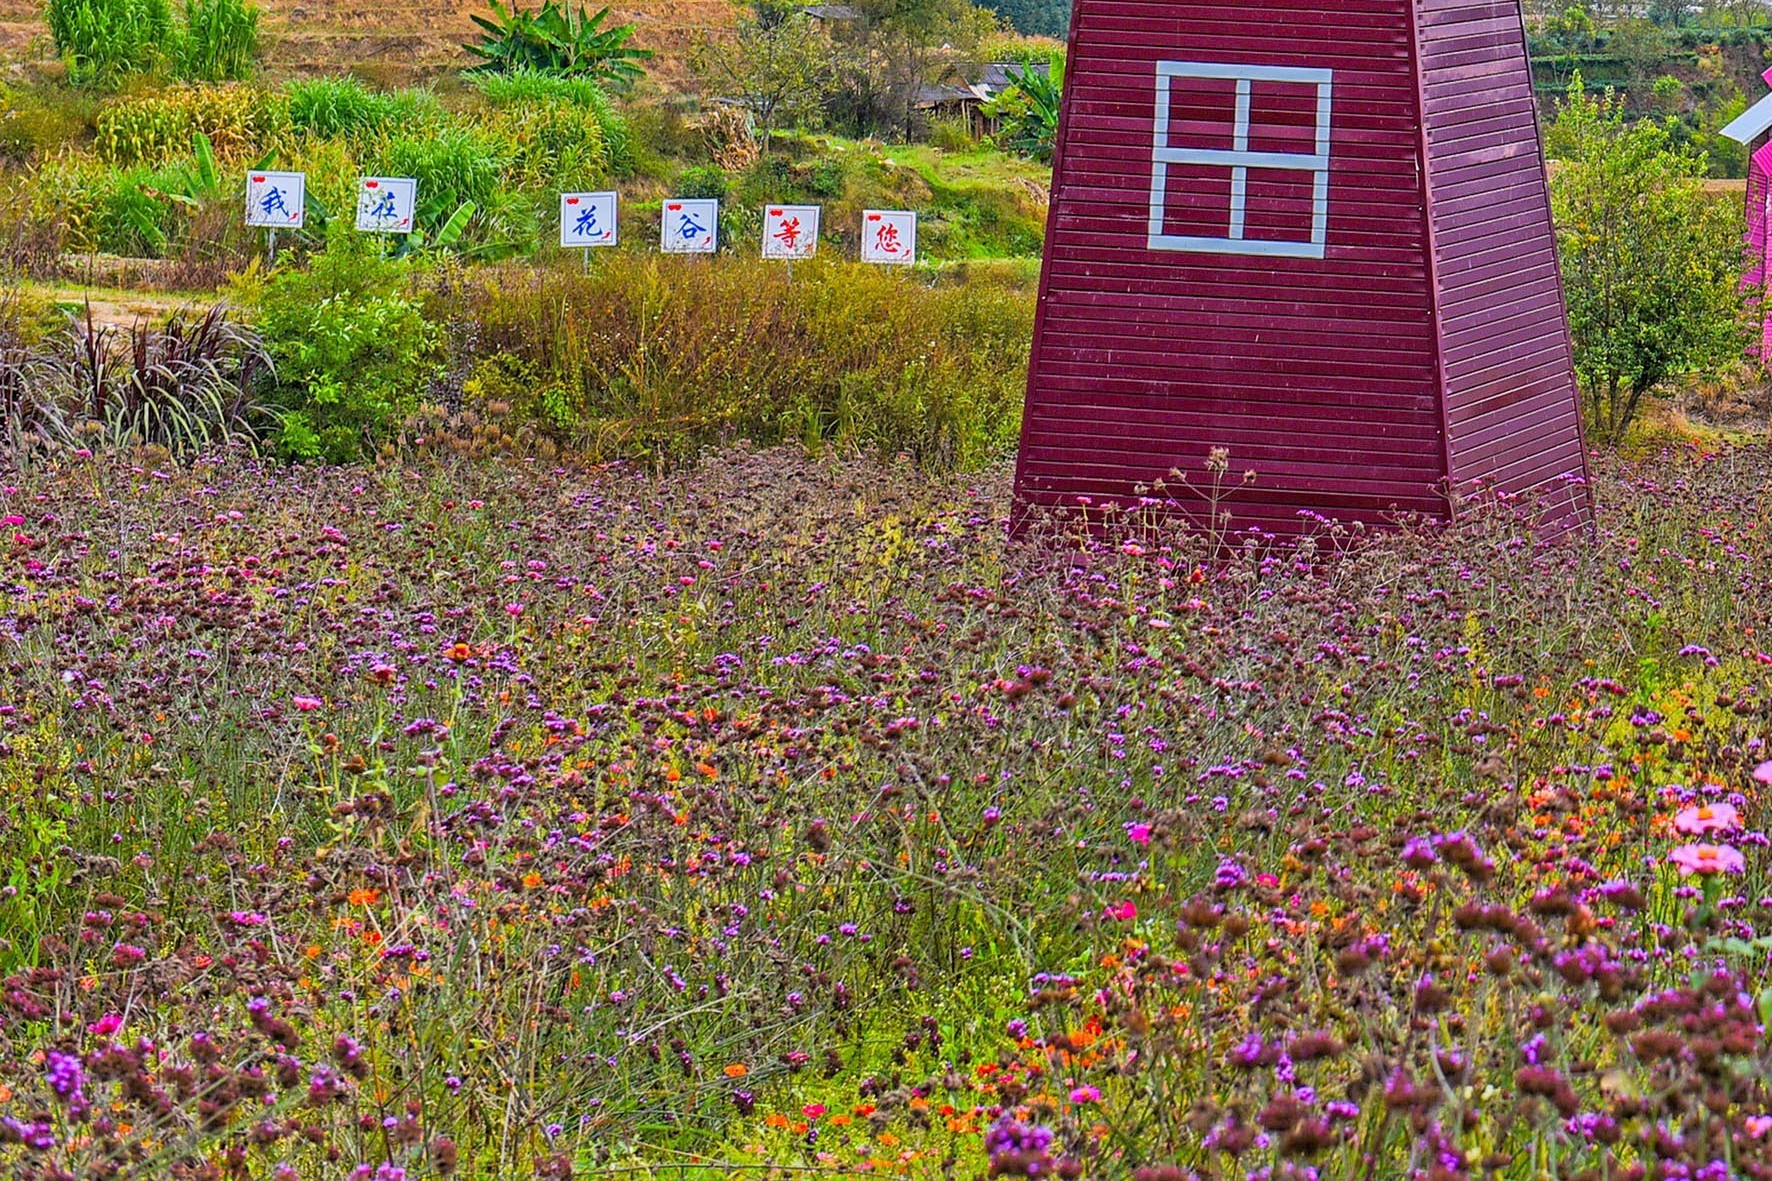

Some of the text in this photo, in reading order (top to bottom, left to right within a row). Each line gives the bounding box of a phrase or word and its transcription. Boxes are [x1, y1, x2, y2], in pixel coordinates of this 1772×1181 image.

[260, 186, 290, 217] 我
[371, 191, 398, 219] 在
[573, 204, 603, 236] 花
[674, 213, 707, 239] 谷
[773, 216, 801, 249] 等
[874, 223, 902, 253] 您
